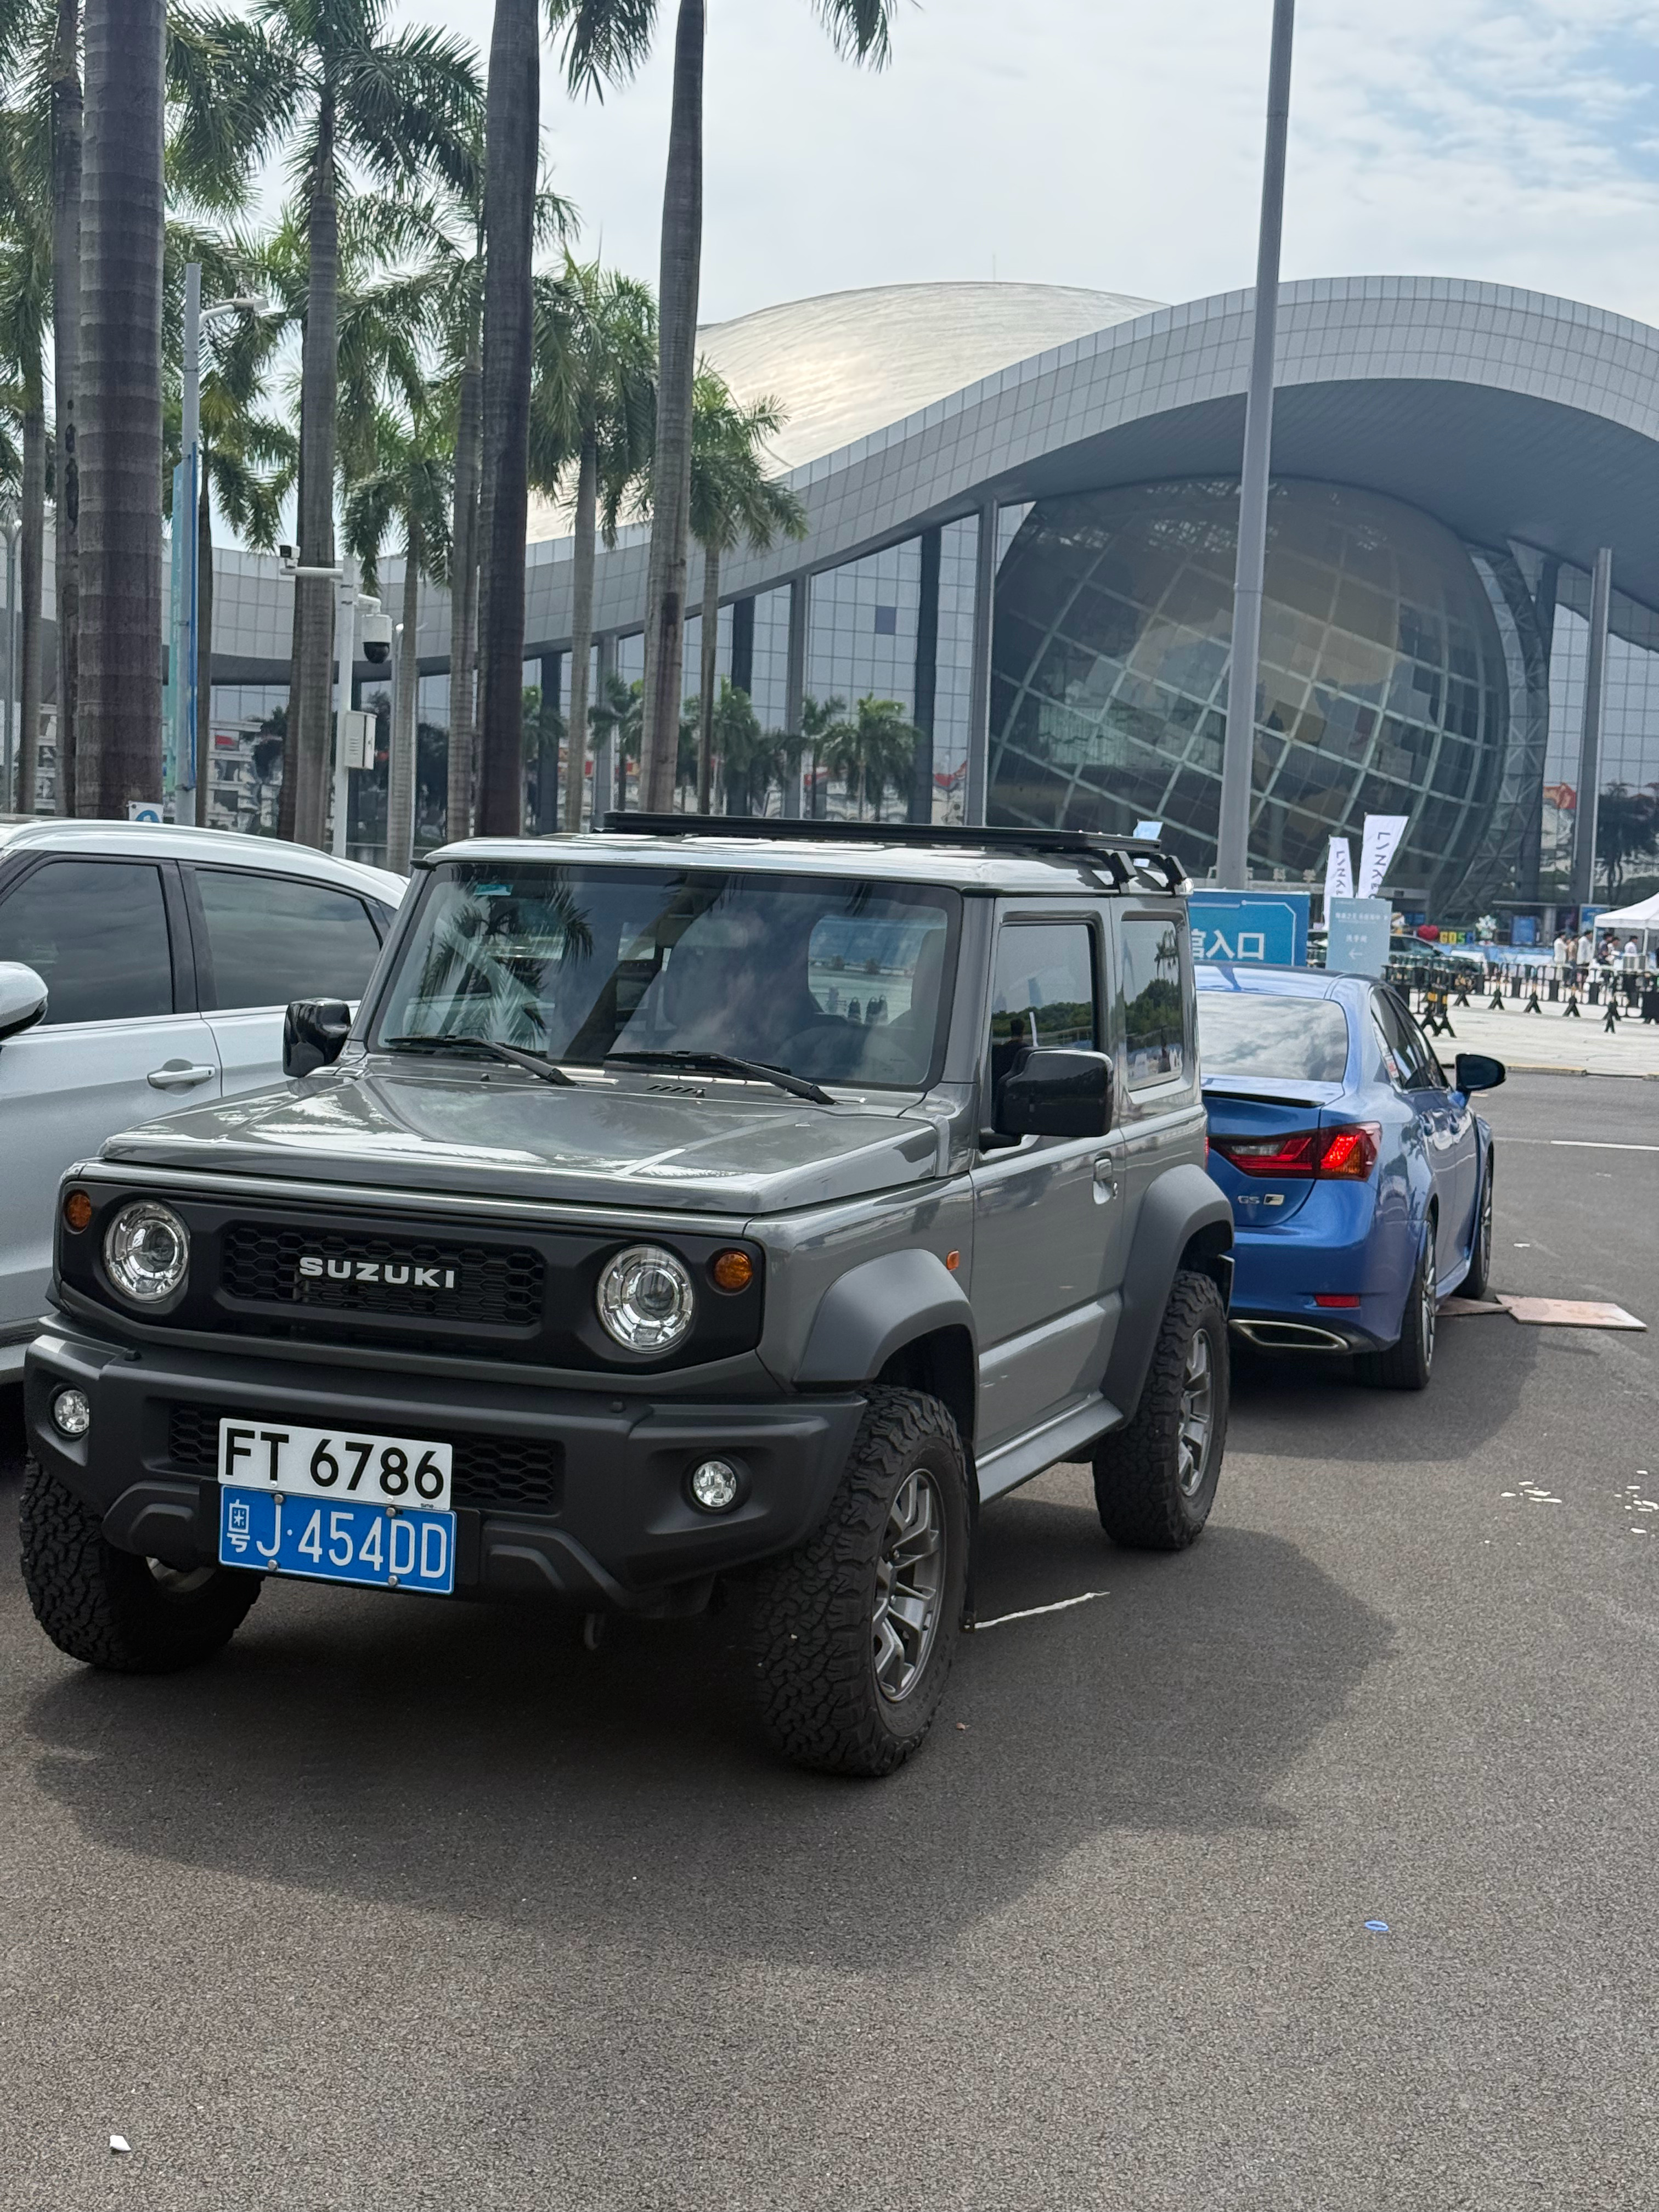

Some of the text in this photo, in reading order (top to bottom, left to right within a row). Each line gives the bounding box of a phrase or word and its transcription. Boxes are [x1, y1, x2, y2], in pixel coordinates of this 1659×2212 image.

[1238, 1195, 1260, 1205] GS
[299, 1256, 455, 1289] SUZUKI
[225, 1427, 444, 1500] FT 6786
